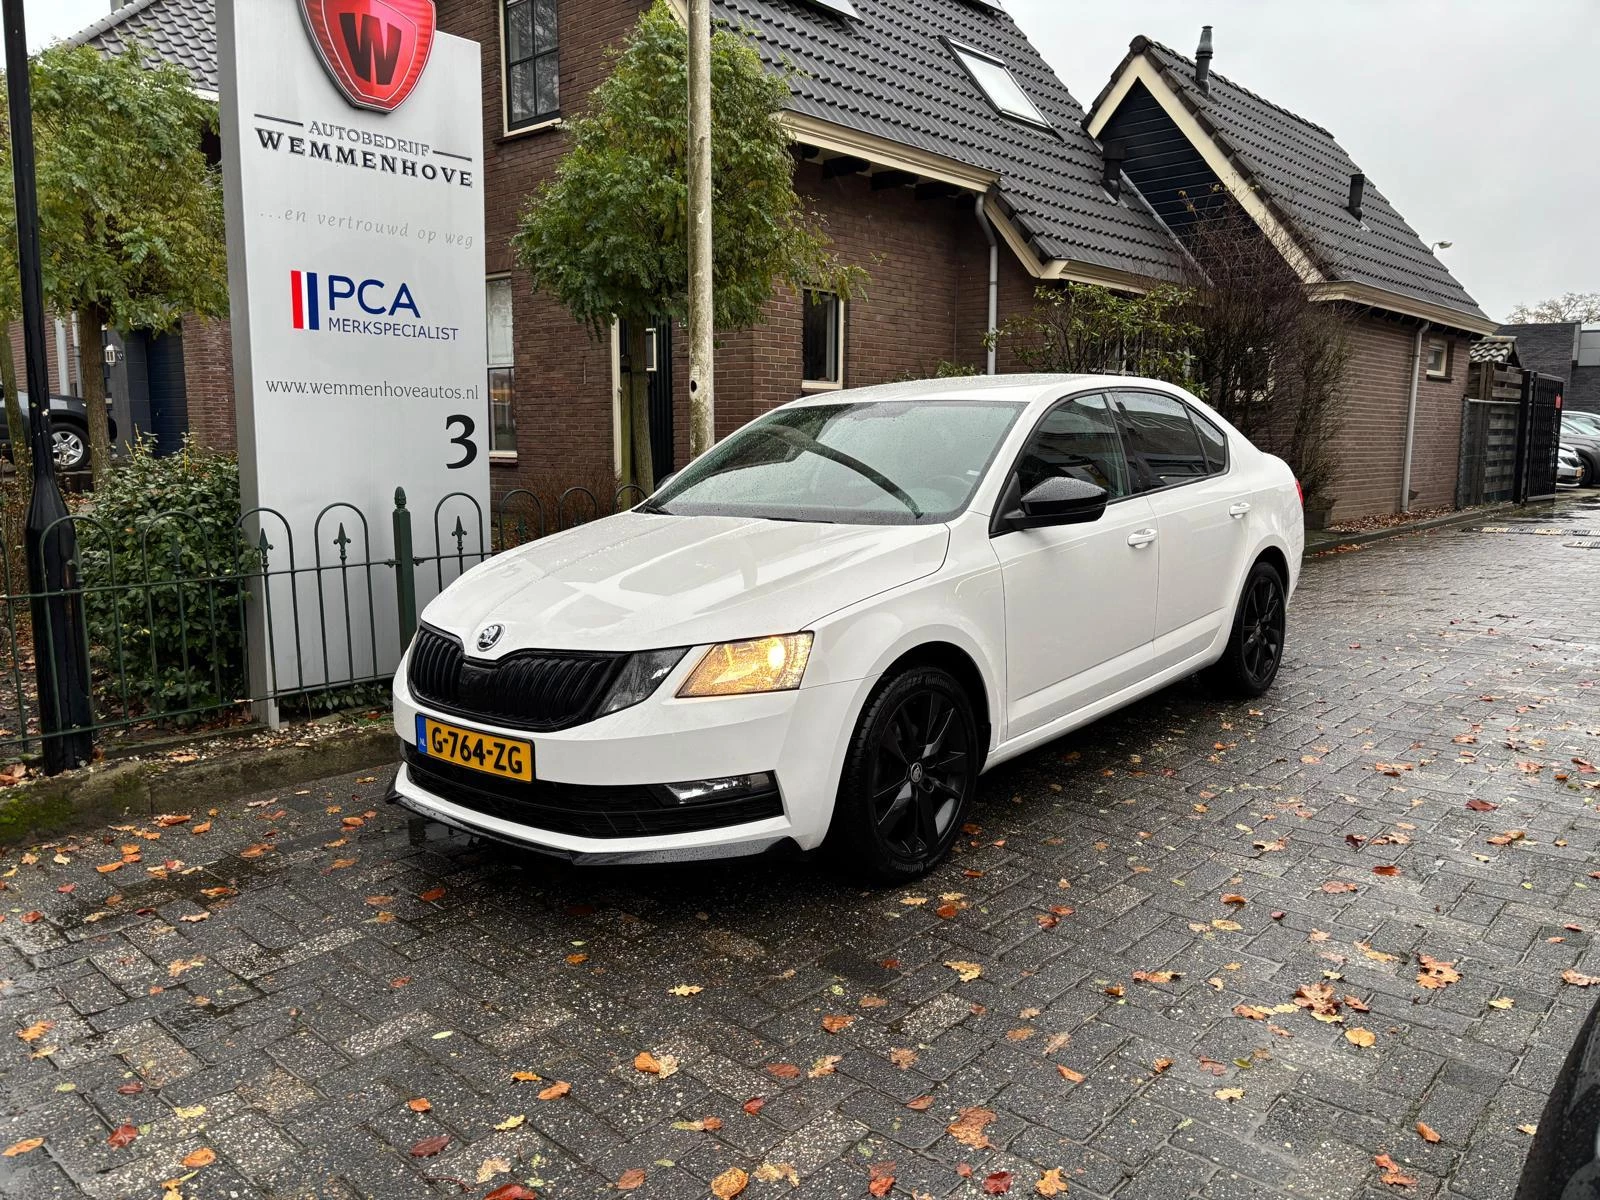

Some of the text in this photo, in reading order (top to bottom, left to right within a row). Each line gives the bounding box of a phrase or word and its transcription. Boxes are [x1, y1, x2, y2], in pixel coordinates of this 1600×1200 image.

[254, 127, 473, 188] WEMMENHOVE
[309, 120, 430, 157] AUTOBEDRIJF
[317, 212, 408, 237] vertrouwd
[417, 229, 436, 242] op
[445, 232, 473, 249] weg
[328, 275, 421, 318] PCA
[328, 317, 459, 341] MERKSPECIALIST
[266, 380, 479, 400] www.wemmenhoveautos.nl
[445, 414, 478, 470] 3
[432, 727, 523, 774] G-764-ZG
